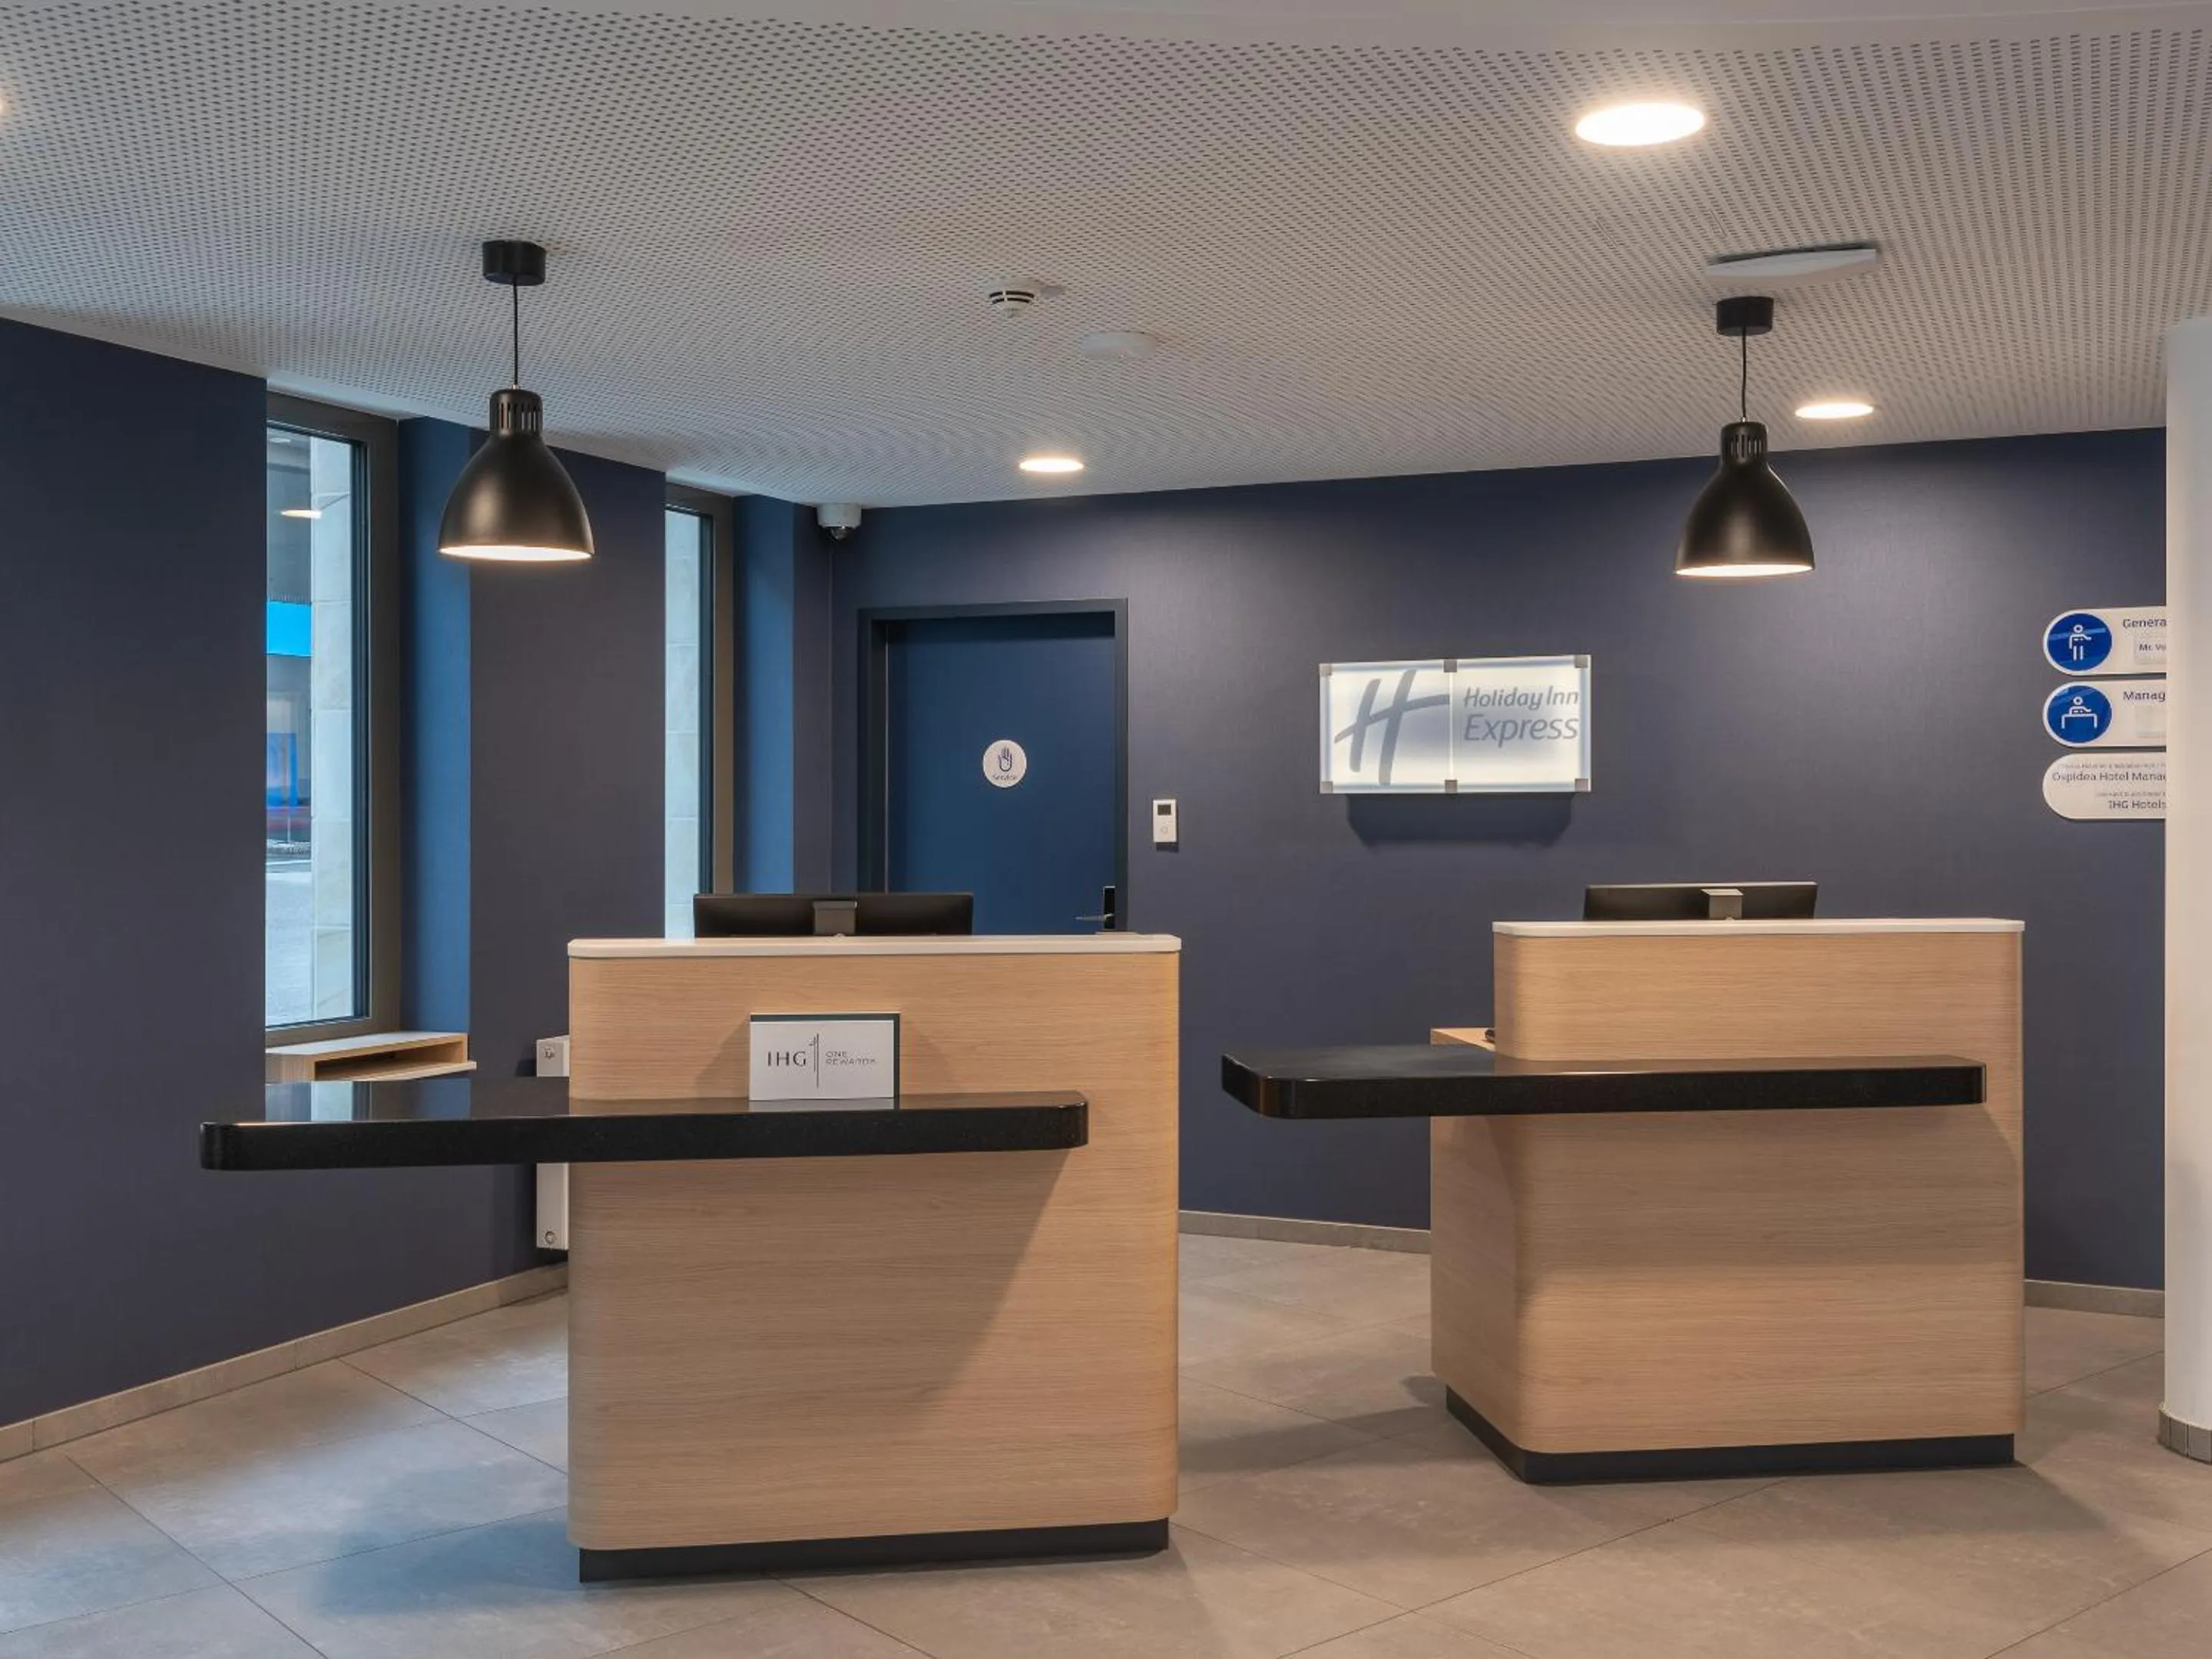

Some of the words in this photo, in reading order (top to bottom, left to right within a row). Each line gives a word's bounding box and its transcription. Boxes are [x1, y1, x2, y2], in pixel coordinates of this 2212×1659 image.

[2123, 618, 2167, 629] Genera
[1463, 687, 1543, 711] Holiday
[1546, 686, 1579, 706] Inn
[2123, 691, 2166, 703] Manag
[1464, 713, 1580, 748] Express
[2100, 771, 2129, 781] Hotel
[2131, 772, 2166, 781] Mana
[2108, 800, 2128, 809] IHG
[767, 1051, 806, 1067] IHG
